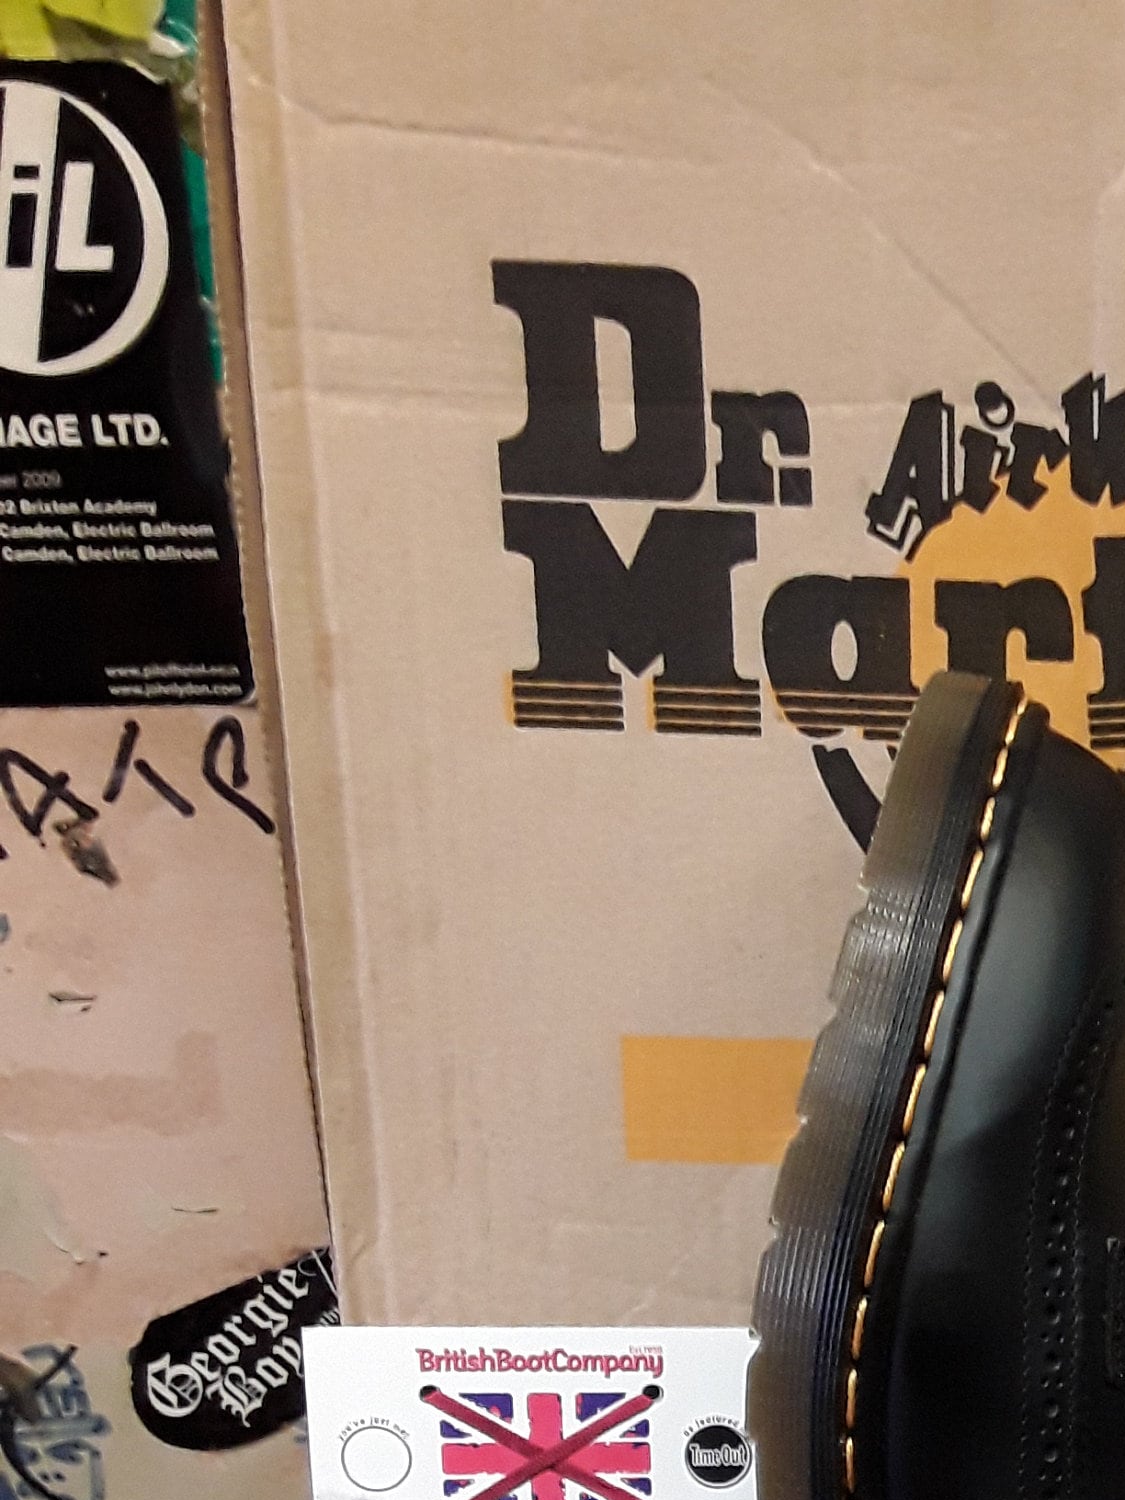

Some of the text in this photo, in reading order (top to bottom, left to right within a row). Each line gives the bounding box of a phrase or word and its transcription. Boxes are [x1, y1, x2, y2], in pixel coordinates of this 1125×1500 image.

[0, 413, 169, 447] AGE LTD.
[72, 521, 137, 538] Electric
[140, 521, 215, 538] Ballroom
[77, 544, 141, 561] Electric
[144, 544, 220, 561] Ballroom
[147, 1268, 310, 1419] Georgie
